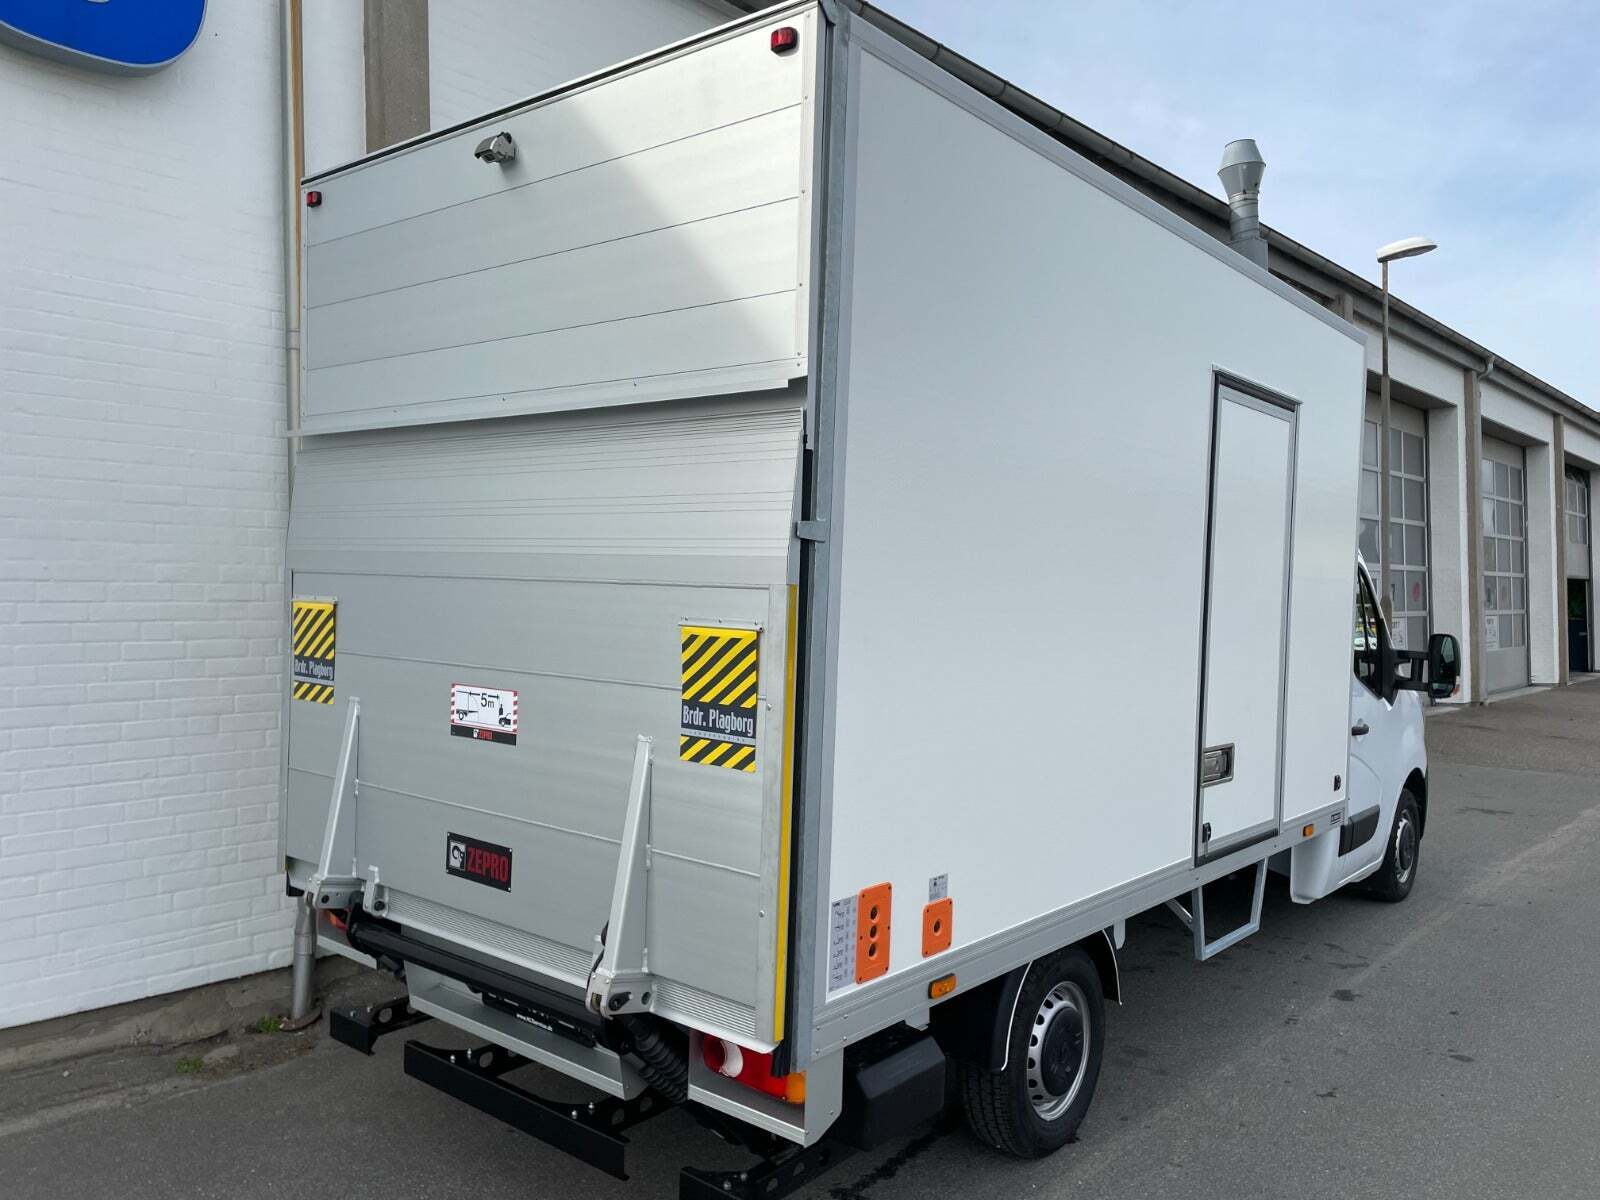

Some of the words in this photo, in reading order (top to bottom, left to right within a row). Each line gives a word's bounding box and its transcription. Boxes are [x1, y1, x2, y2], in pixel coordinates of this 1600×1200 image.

[682, 705, 707, 727] Brdr.
[708, 708, 754, 737] Plagborg
[467, 847, 509, 883] ZEPRO
